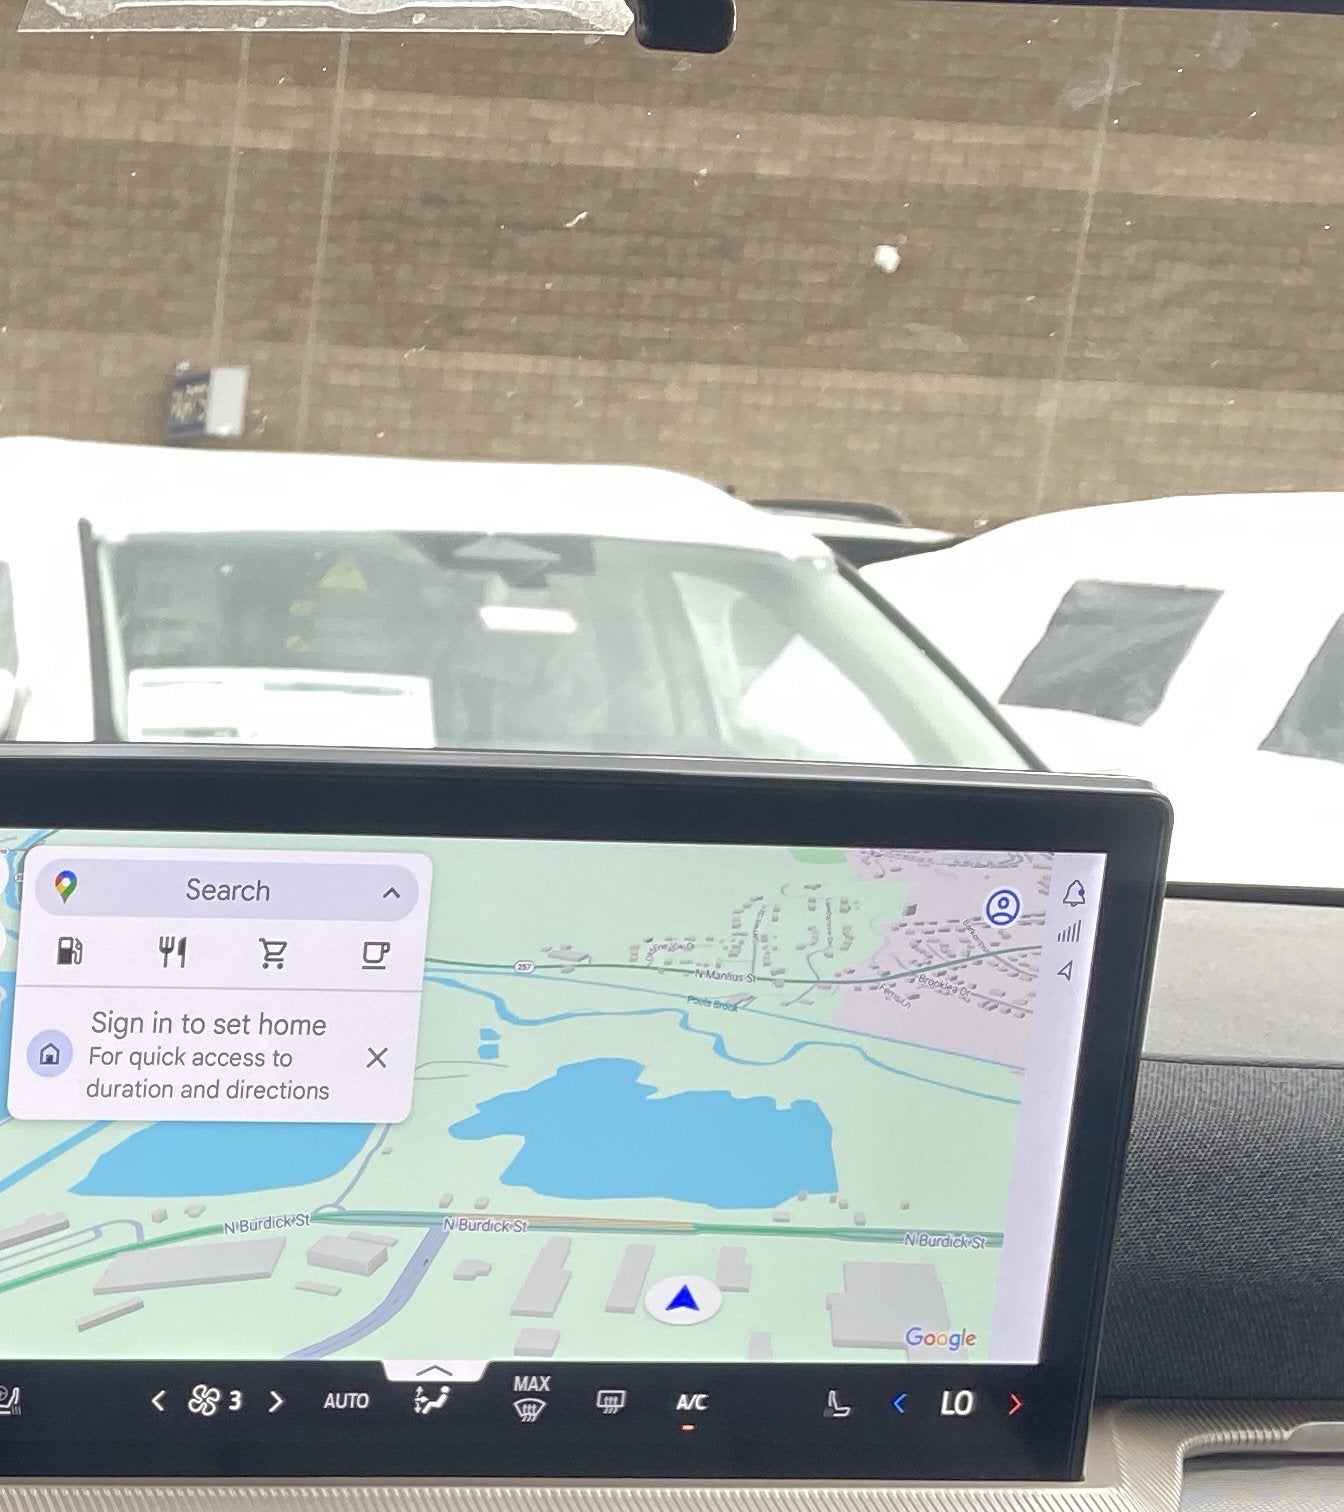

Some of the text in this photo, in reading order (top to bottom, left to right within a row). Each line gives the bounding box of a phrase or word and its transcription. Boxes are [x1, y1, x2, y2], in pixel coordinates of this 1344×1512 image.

[185, 877, 270, 902] Search
[91, 1010, 327, 1039] Sign in to set home
[89, 1046, 293, 1070] For quick access to
[86, 1078, 330, 1100] duration and directions
[224, 1213, 310, 1235] N Burdick St
[443, 1218, 527, 1233] N Burdick St
[904, 1233, 986, 1249] N Burdick St
[905, 1326, 977, 1351] Google
[514, 1375, 551, 1392] MAX
[228, 1390, 242, 1410] 3
[323, 1392, 370, 1409] AUTO
[675, 1393, 710, 1410] A/C
[941, 1390, 973, 1415] LO
